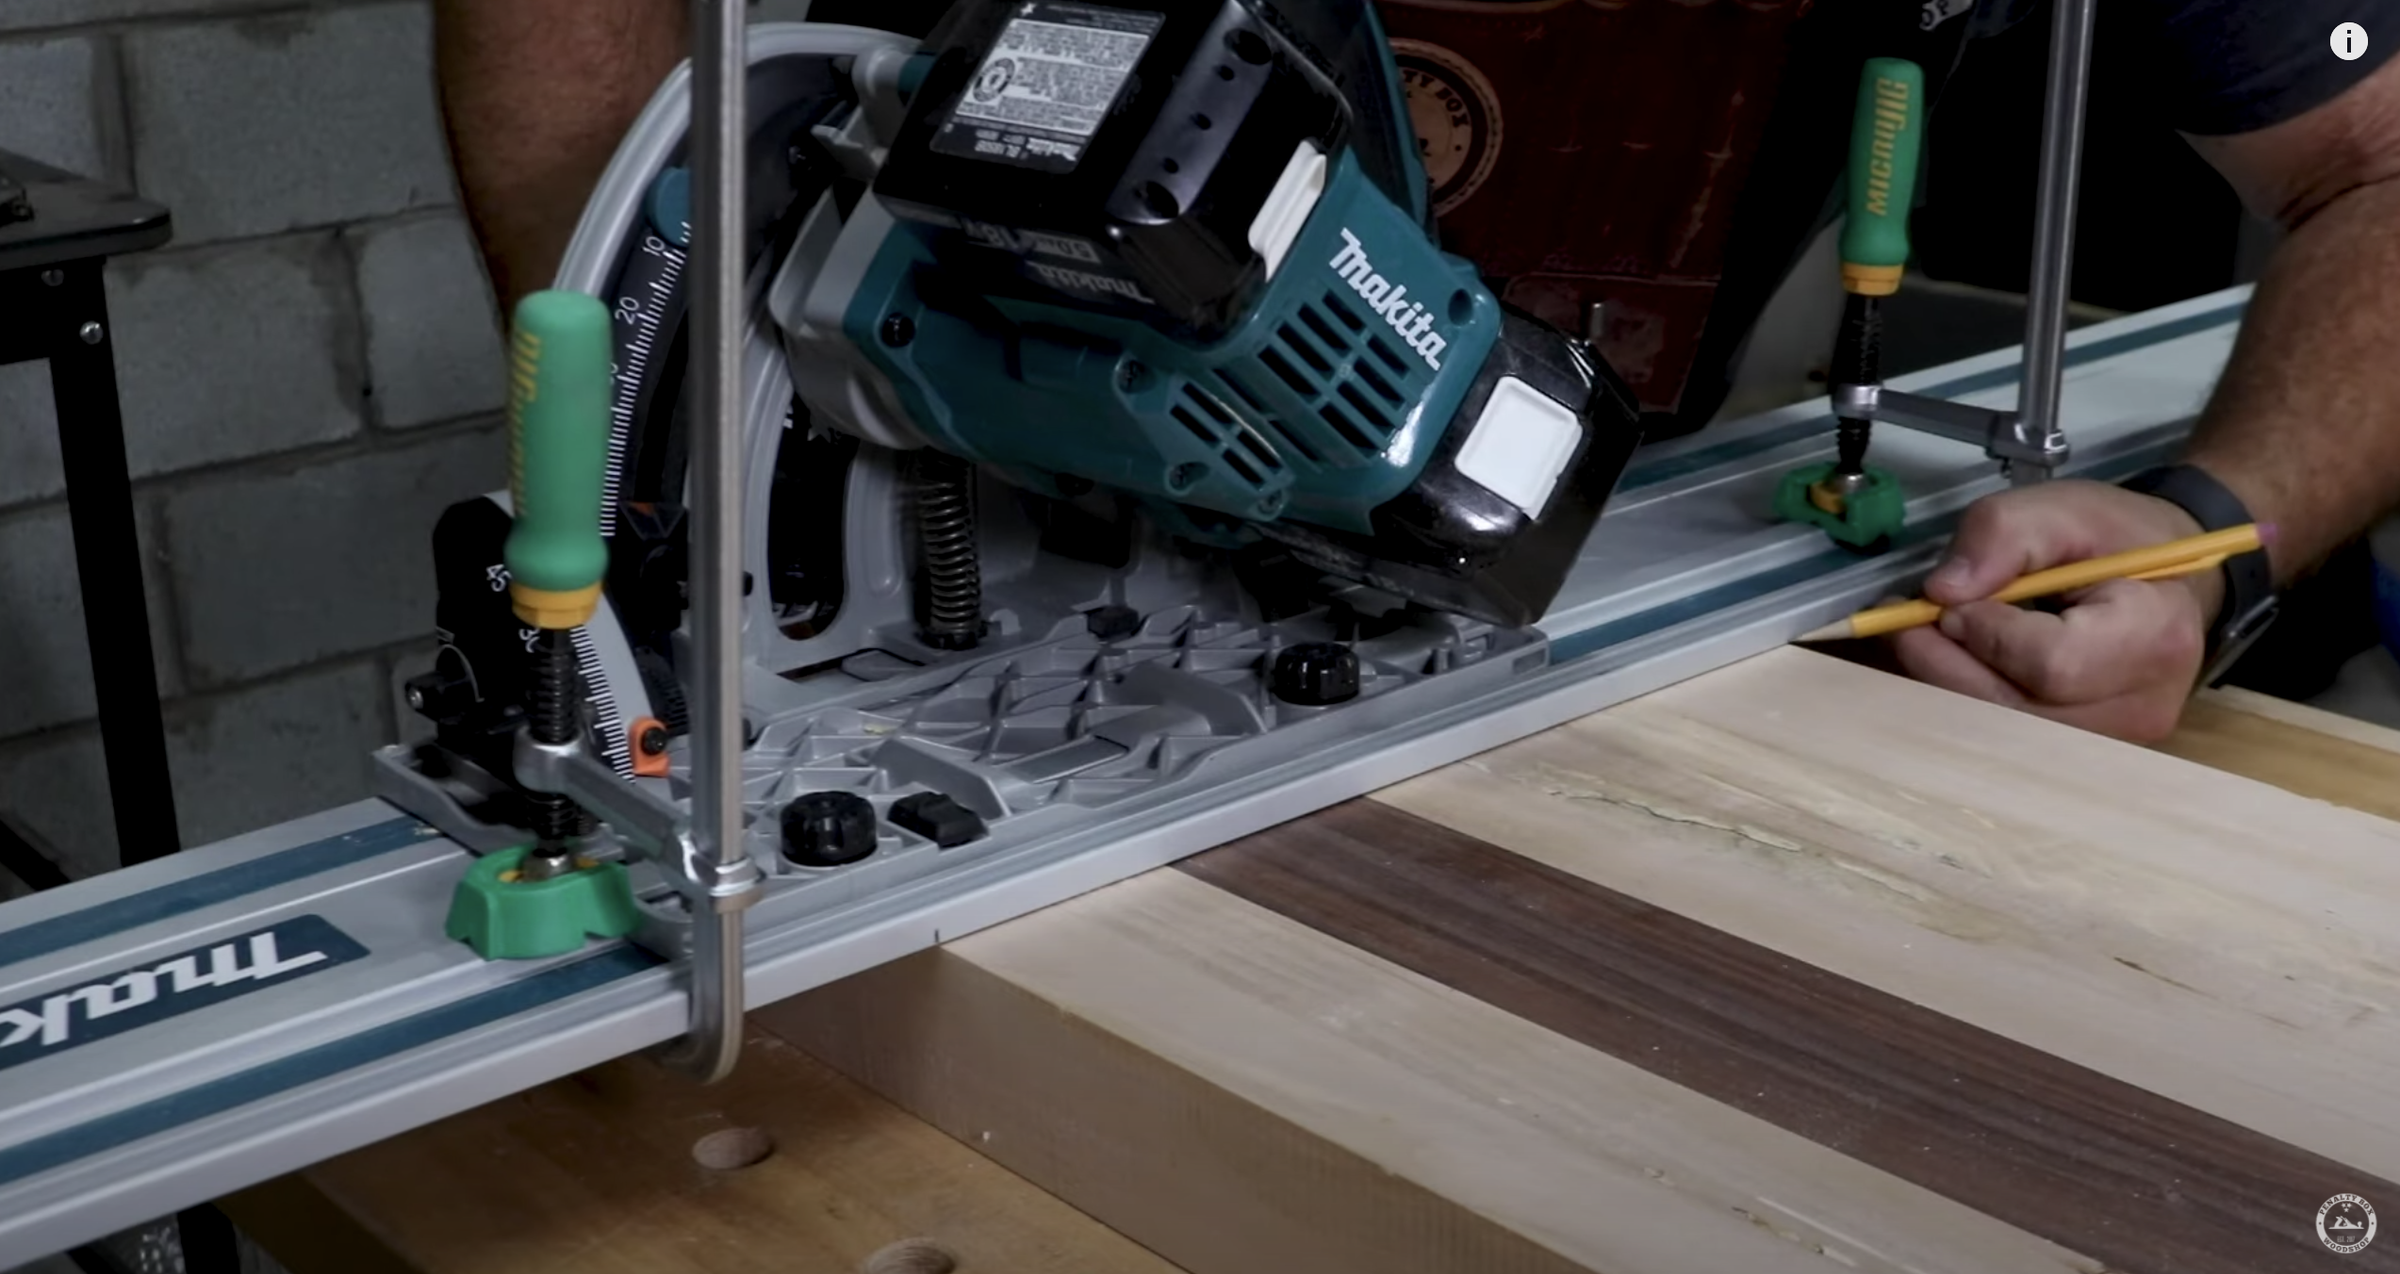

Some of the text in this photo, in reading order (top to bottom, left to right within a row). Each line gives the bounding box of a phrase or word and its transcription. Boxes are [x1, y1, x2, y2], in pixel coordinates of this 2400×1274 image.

[642, 235, 666, 257] 10
[615, 296, 640, 325] 20
[1329, 227, 1447, 371] Makita
[486, 563, 513, 592] 45
